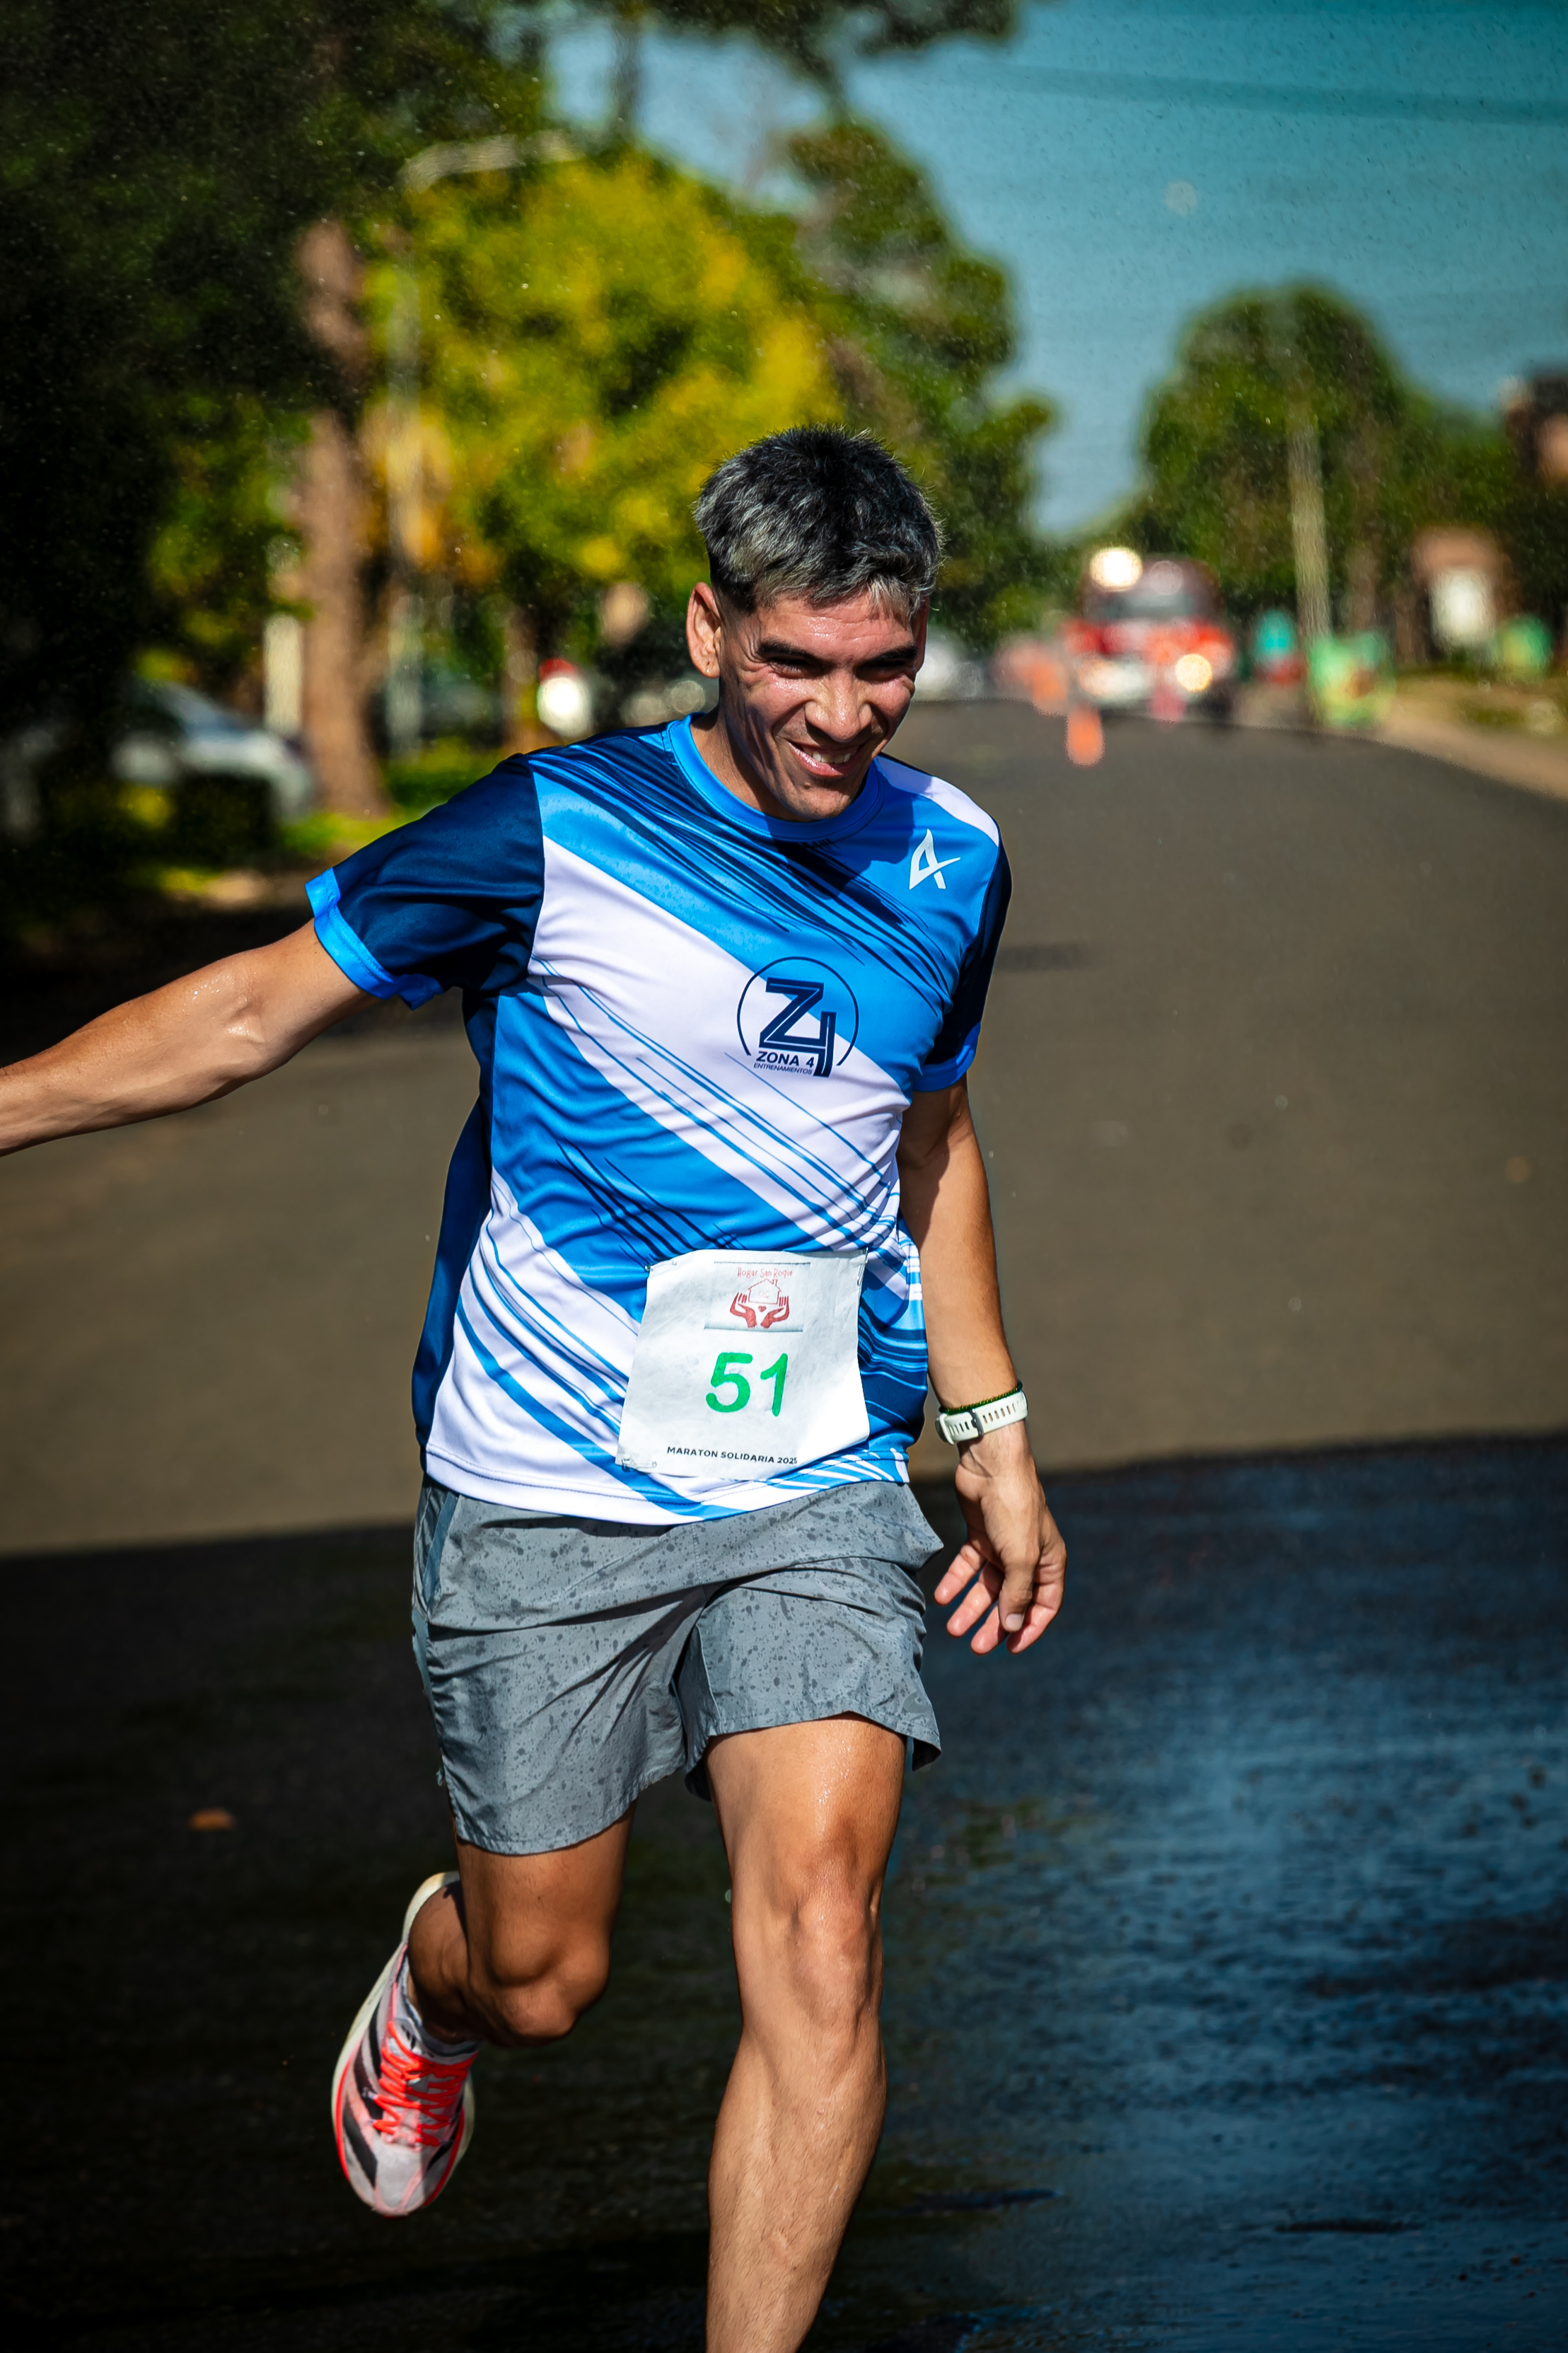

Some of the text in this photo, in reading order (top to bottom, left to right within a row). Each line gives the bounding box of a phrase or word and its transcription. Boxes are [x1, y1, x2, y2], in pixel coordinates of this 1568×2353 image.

[755, 1051, 815, 1068] ZONA 4
[753, 1062, 813, 1075] ENTRENAMIENTOS
[737, 1267, 793, 1279] Hogar San Roque
[705, 1352, 789, 1417] 51
[667, 1446, 798, 1465] MARATON SOLIDARIA 2025
